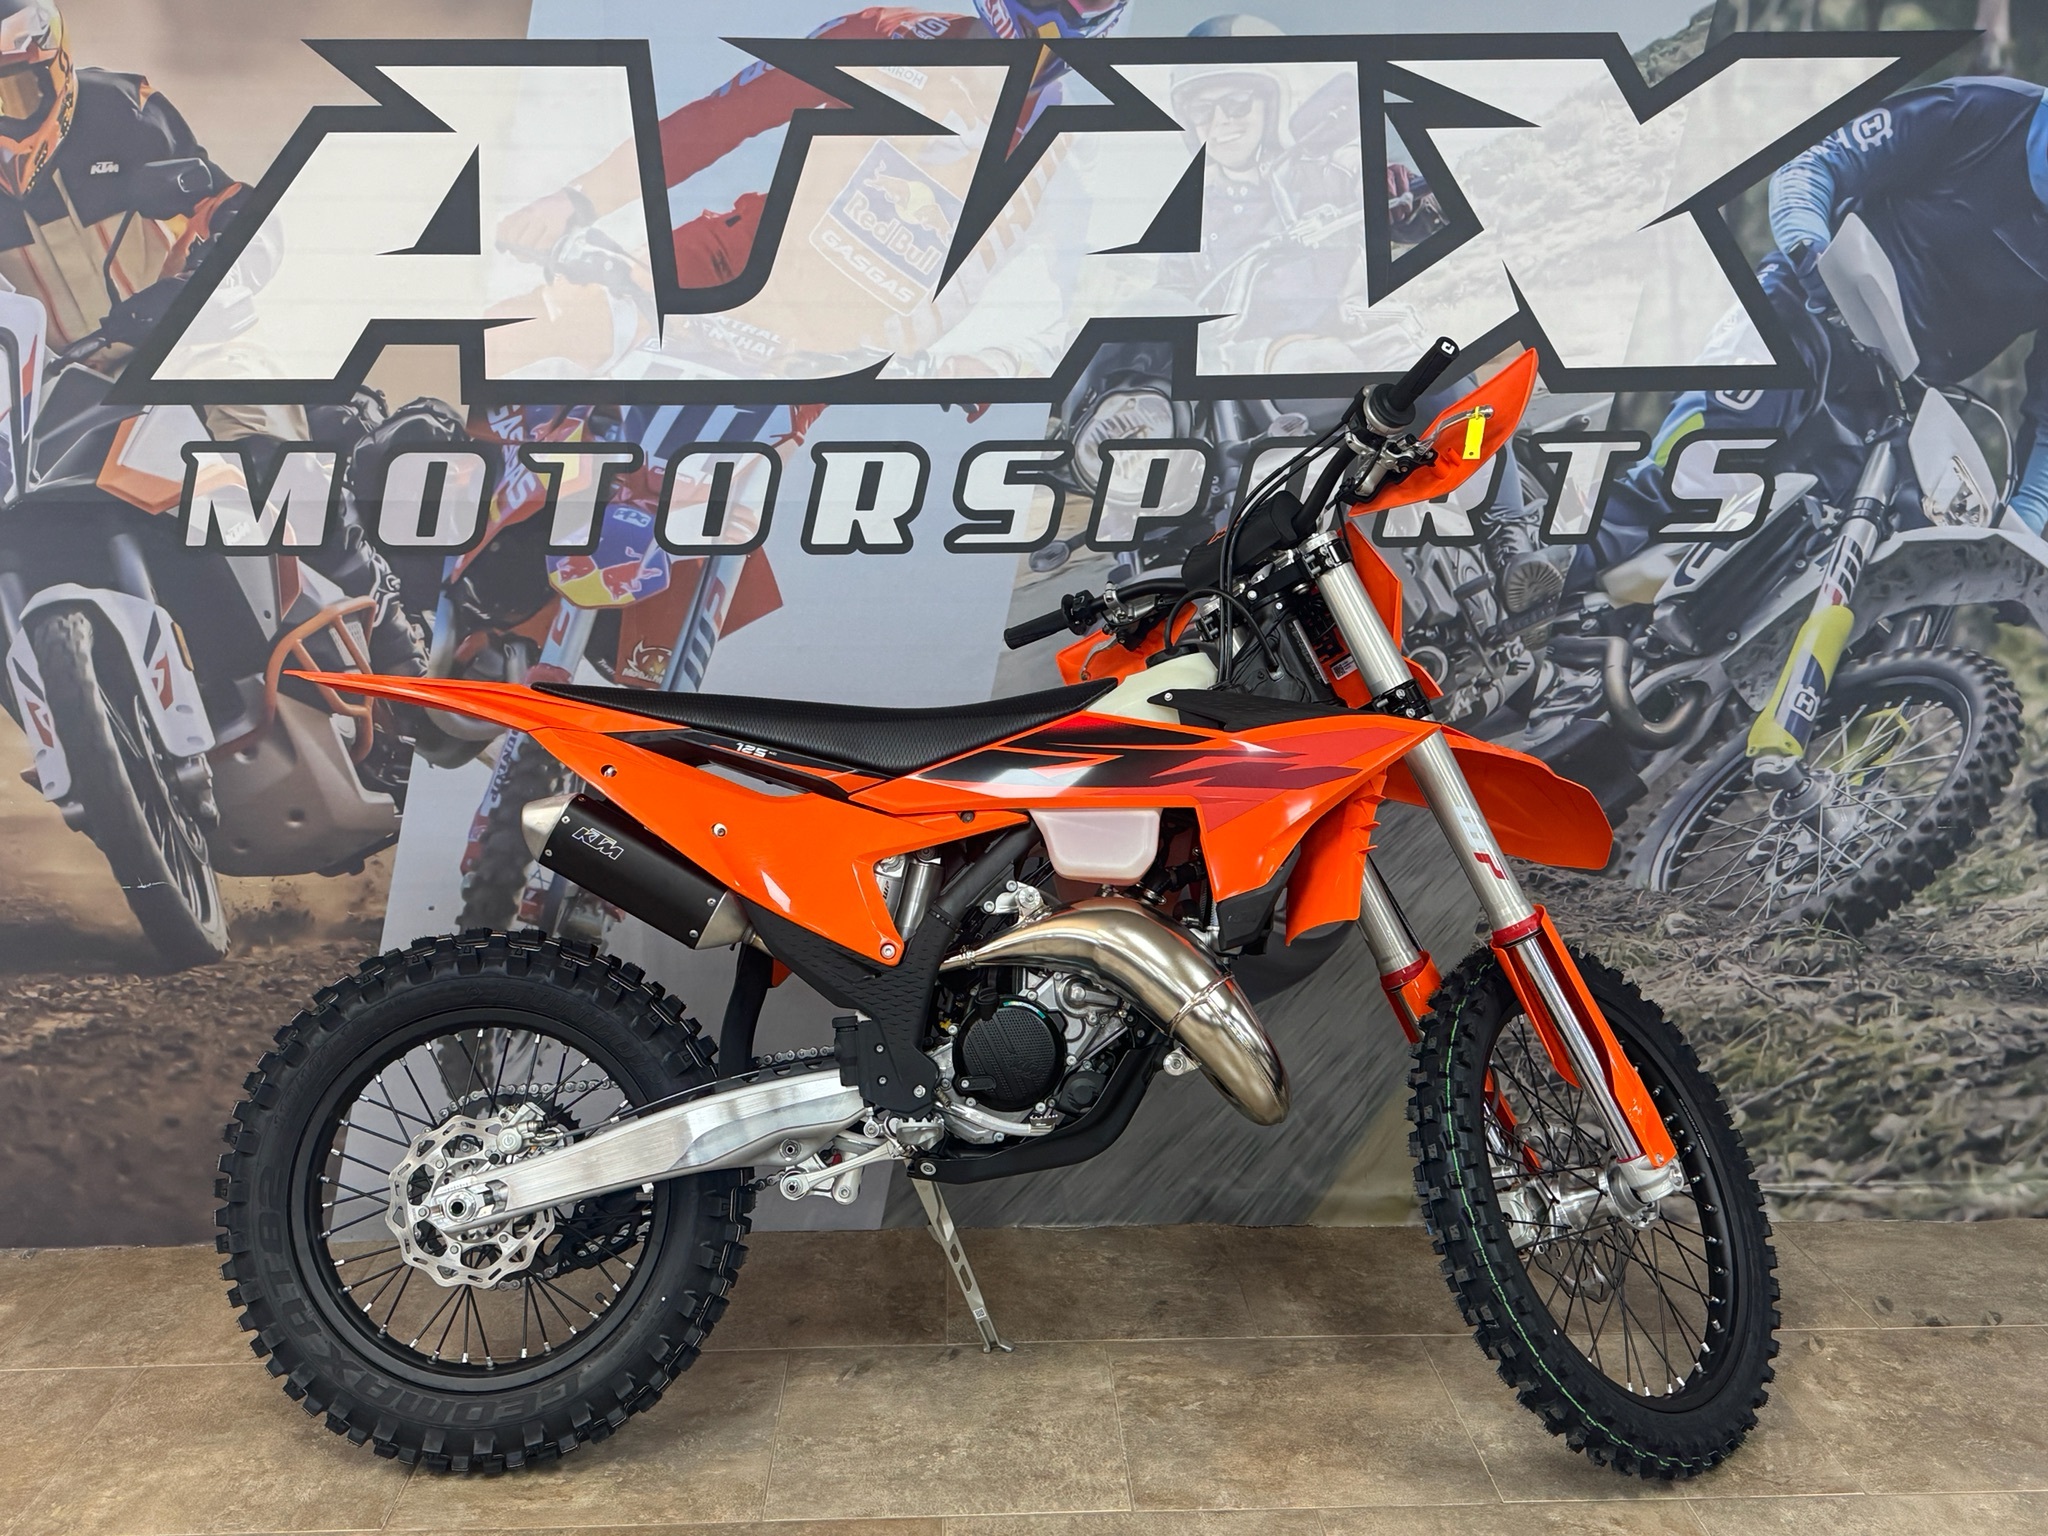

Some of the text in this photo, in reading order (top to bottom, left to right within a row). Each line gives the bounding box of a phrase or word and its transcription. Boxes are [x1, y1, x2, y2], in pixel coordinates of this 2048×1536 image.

[90, 161, 119, 175] KTM
[106, 31, 1986, 404] AJAX
[821, 229, 916, 303] GASGAS
[736, 742, 769, 758] 125
[571, 826, 625, 861] KTM
[311, 1341, 584, 1425] GEOMAX
